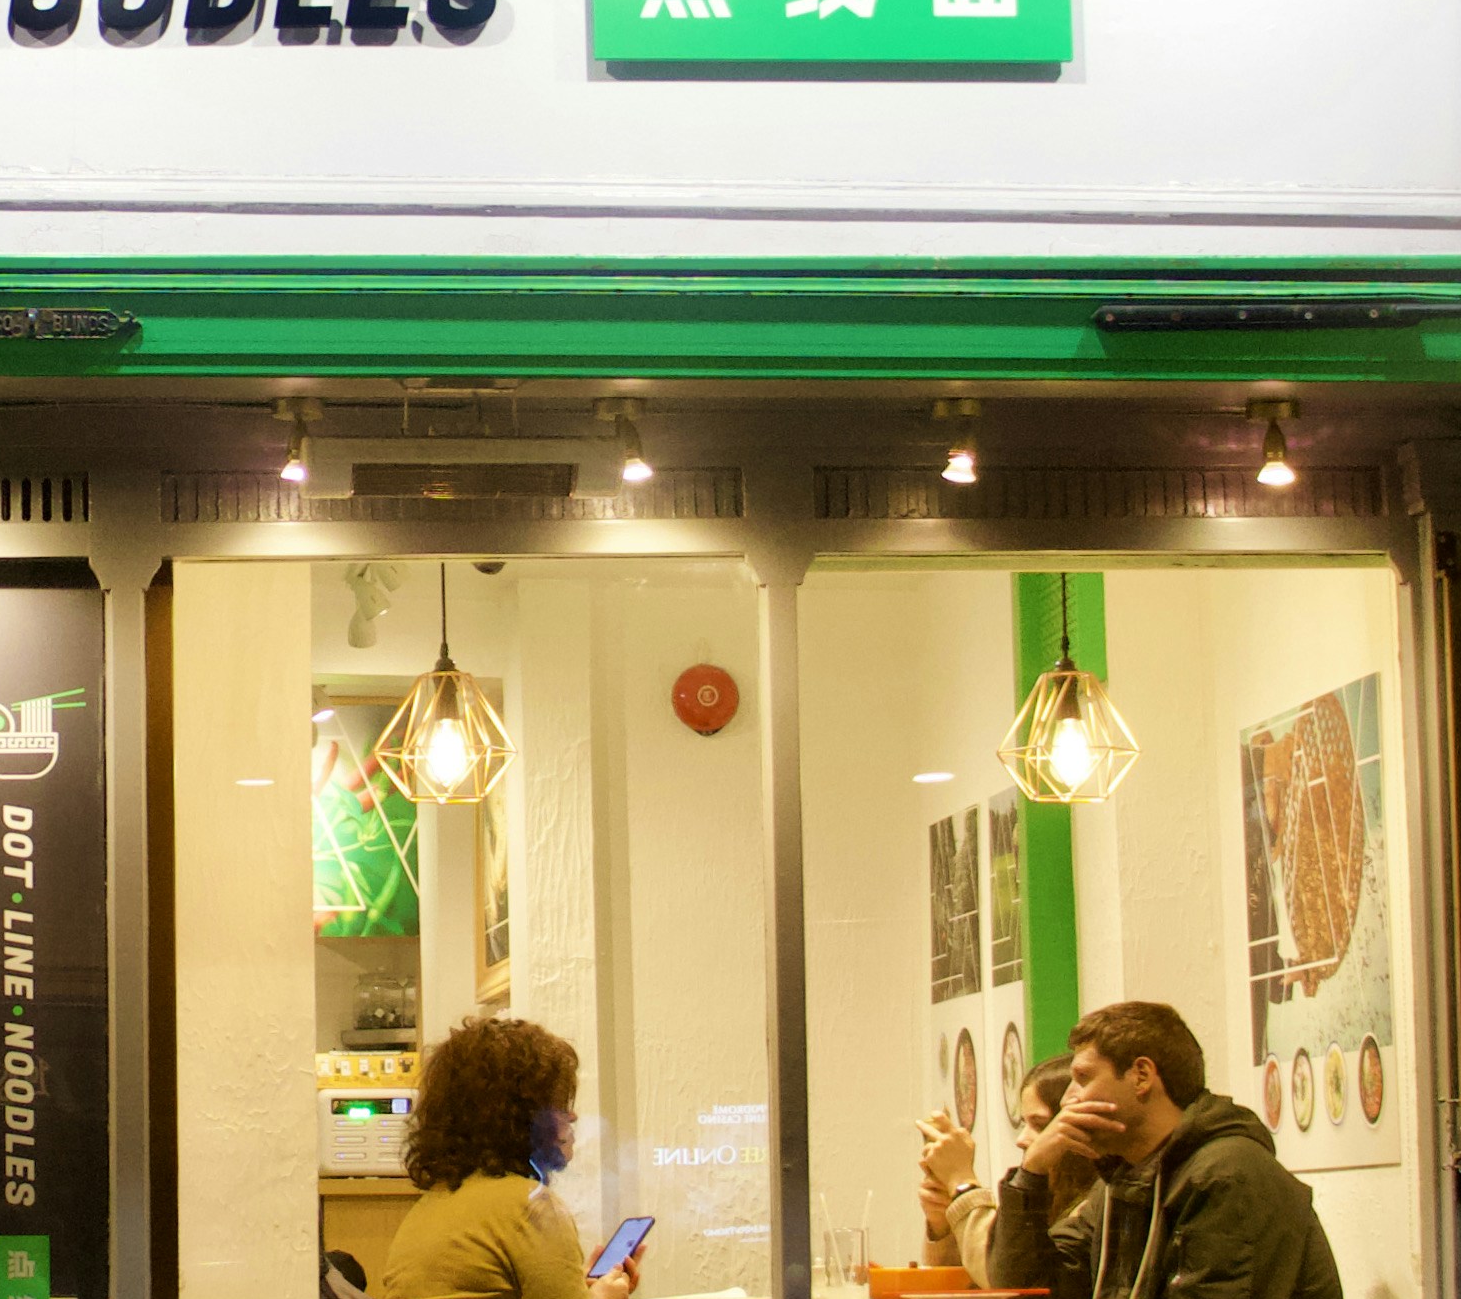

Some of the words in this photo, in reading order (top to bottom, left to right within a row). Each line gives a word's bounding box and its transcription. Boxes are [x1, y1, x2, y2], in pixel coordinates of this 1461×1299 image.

[52, 313, 110, 332] BLINDS
[2, 804, 34, 890] DOT
[2, 909, 34, 1001] LINE
[3, 1021, 36, 1208] NOODLES
